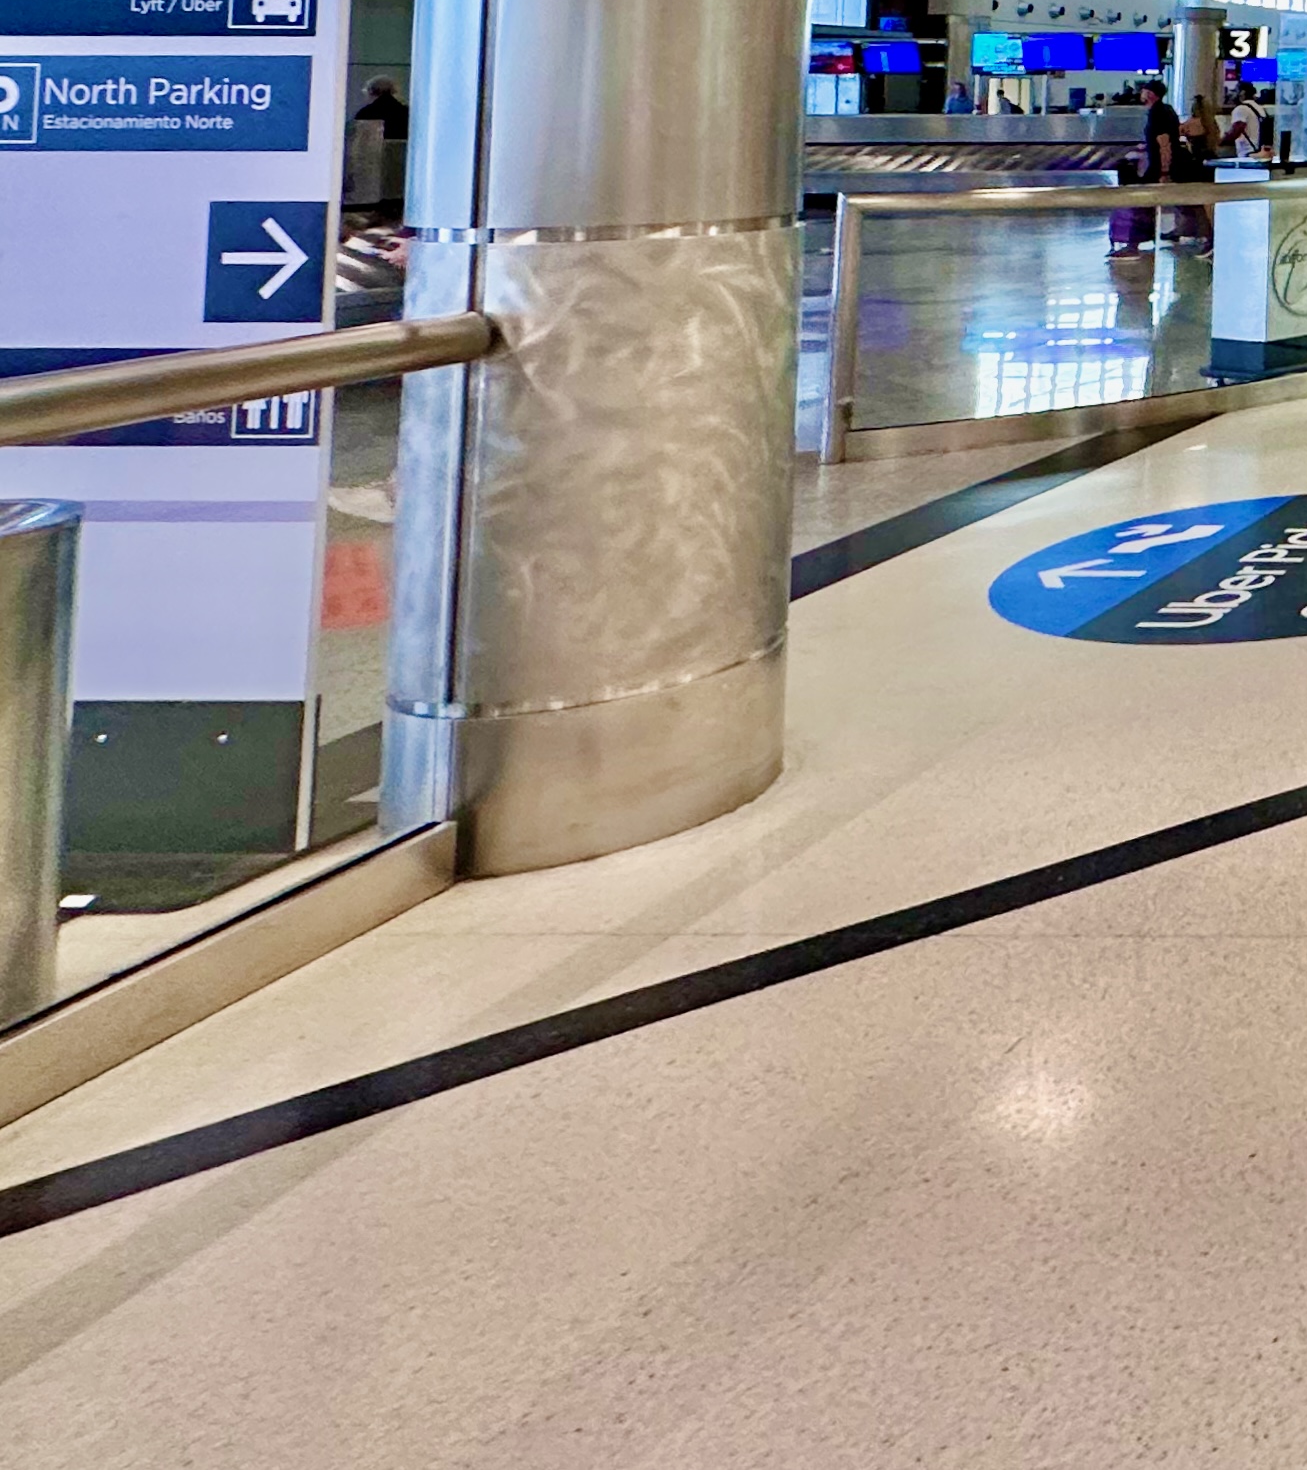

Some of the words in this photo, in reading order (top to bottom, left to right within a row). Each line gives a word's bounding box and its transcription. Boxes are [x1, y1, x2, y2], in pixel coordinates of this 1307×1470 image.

[1229, 30, 1251, 58] 3
[43, 77, 138, 106] North
[148, 76, 273, 111] Parking
[2, 114, 20, 131] N
[43, 114, 182, 131] Estacionamiento
[185, 114, 235, 131] Norte
[1135, 564, 1287, 629] Uber
